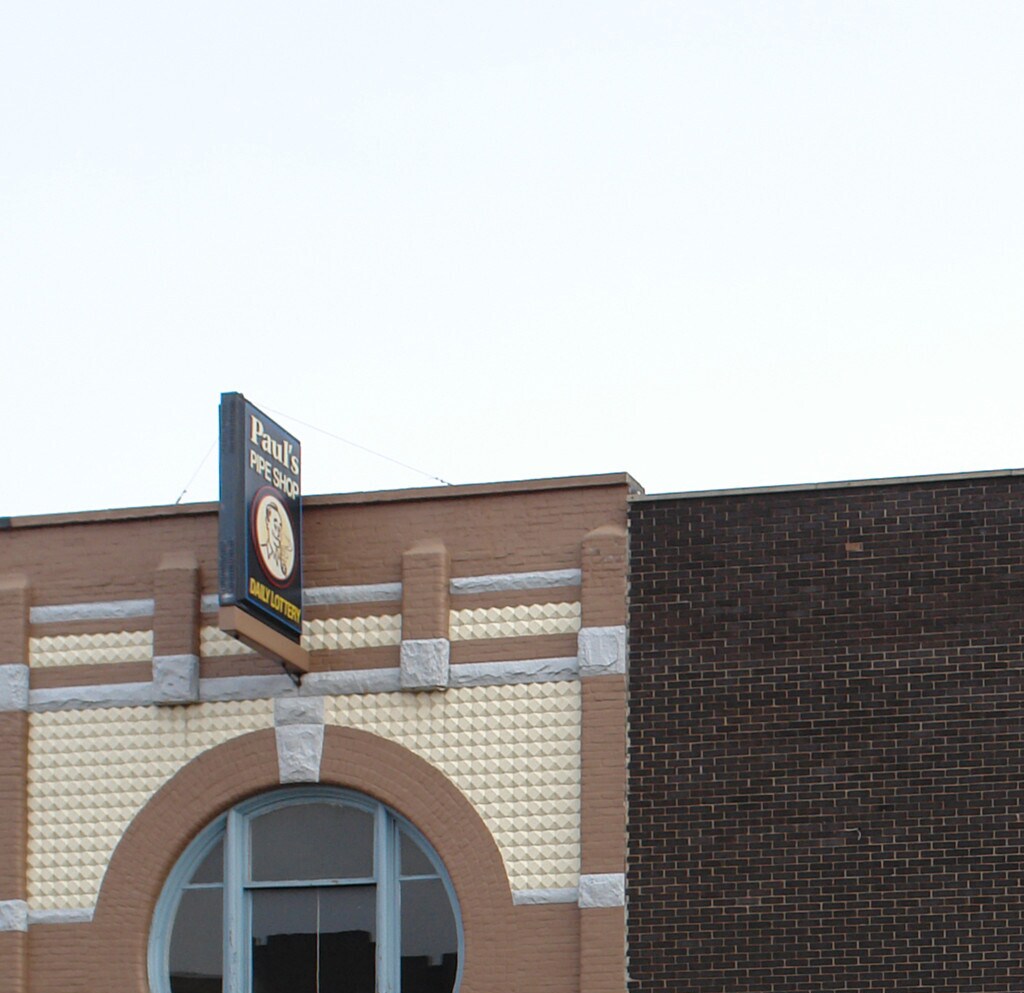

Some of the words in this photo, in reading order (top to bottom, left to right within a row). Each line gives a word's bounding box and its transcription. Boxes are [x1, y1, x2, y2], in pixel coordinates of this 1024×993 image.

[251, 415, 299, 475] Paul's
[250, 449, 272, 482] PIPE
[273, 467, 299, 500] SHOP
[249, 577, 270, 604] DAILY
[270, 590, 301, 623] LOTTERY
